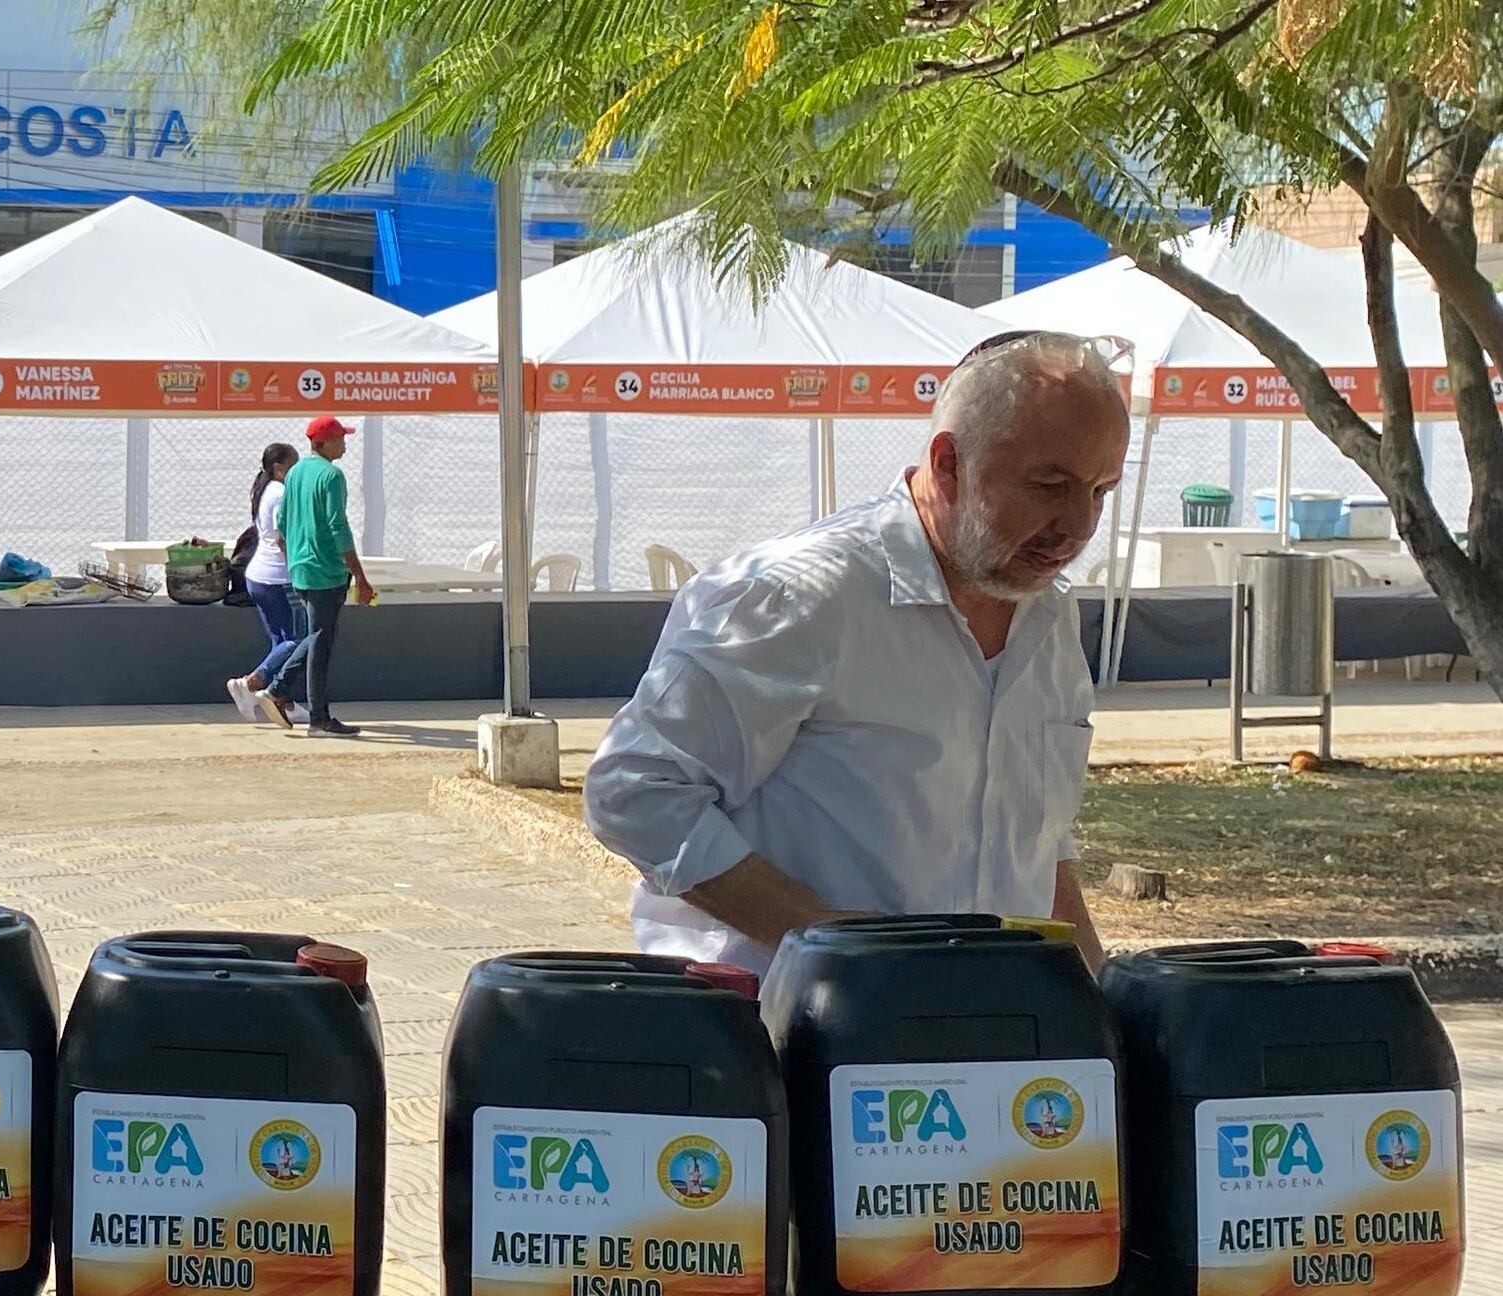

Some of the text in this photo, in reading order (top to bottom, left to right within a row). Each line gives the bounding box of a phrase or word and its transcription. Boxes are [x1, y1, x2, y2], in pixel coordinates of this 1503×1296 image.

[16, 367, 93, 381] VANESSA
[335, 372, 398, 384] ROSALBA
[650, 372, 700, 385] CECILIA
[16, 383, 100, 400] MARTÍNEZ
[303, 378, 321, 391] 35
[619, 380, 638, 394] 34
[918, 382, 936, 394] 33
[1227, 383, 1244, 397] 32
[334, 388, 432, 400] BLANQUICETT
[649, 387, 774, 401] MARRIAGA BLANCO
[852, 1089, 966, 1142] EPA
[93, 1119, 204, 1176] EPA
[855, 1145, 968, 1156] CARTAGENA
[1217, 1122, 1323, 1178] EPA
[493, 1135, 610, 1193] EPA
[94, 1174, 204, 1188] CARTAGENA
[1220, 1178, 1324, 1191] CARTAGENA
[495, 1191, 610, 1206] CARTAGENA
[856, 1180, 1100, 1216] ACEITE DE COCINA
[90, 1213, 333, 1256] ACEITE DE COCINA
[935, 1221, 1021, 1252] USADO
[1219, 1210, 1444, 1250] ACEITE DE COCINA
[492, 1232, 743, 1275] ACEITE DE COCINA
[167, 1255, 252, 1288] USADO
[1294, 1253, 1372, 1284] USADO
